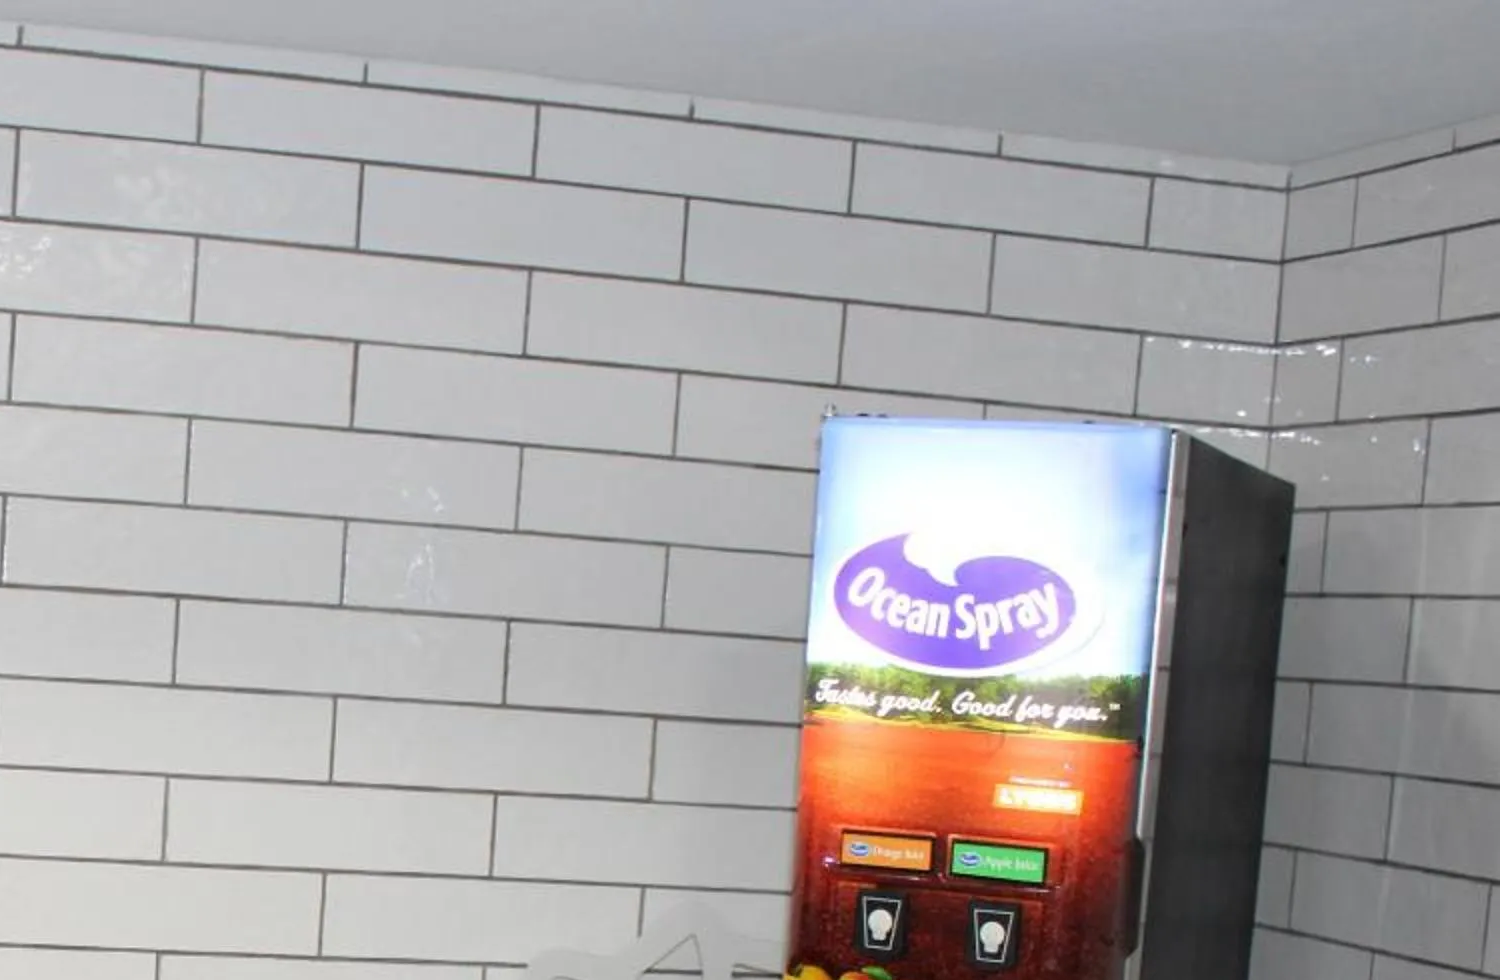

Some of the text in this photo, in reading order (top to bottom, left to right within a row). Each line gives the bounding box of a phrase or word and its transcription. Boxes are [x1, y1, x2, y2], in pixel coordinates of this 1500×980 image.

[847, 566, 1061, 651] Ocean Spray
[877, 690, 942, 716] good.
[951, 691, 1014, 718] Good
[1014, 696, 1055, 722] for
